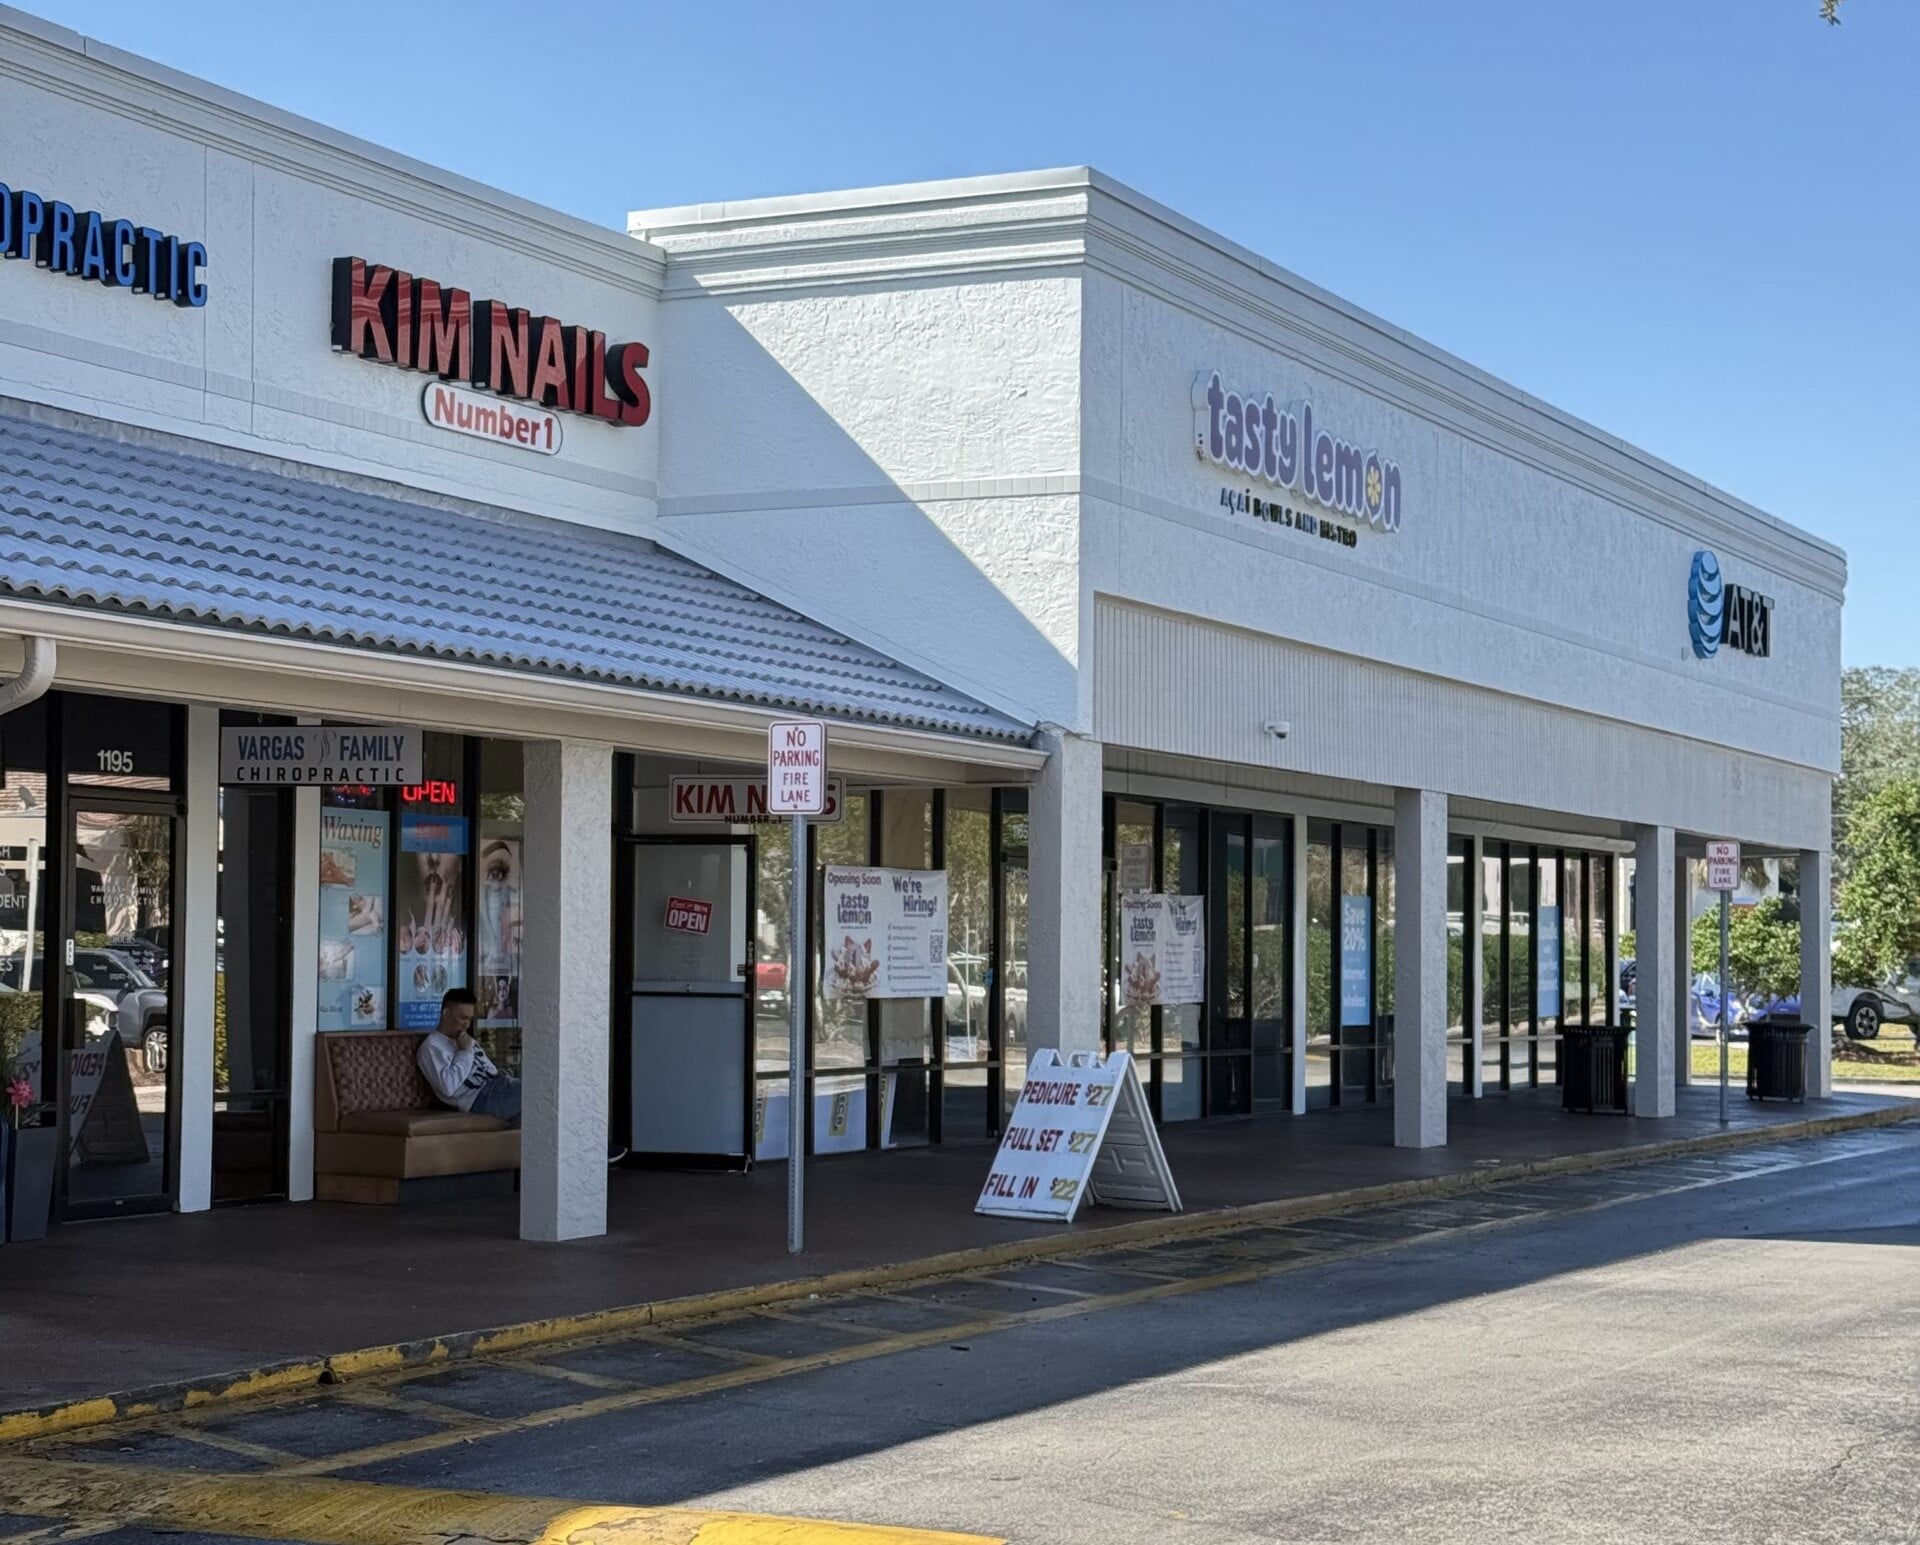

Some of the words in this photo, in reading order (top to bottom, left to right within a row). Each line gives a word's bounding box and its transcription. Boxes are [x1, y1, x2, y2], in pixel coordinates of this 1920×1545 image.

[334, 255, 472, 383] KIM
[475, 299, 651, 428] NAILS
[1208, 372, 1298, 487] tasty
[1303, 401, 1401, 531] lemon
[1295, 512, 1317, 534] AND
[1723, 583, 1775, 658] AT&T
[237, 735, 305, 761] VARGAS
[339, 735, 405, 762] FAMILY
[786, 729, 807, 748] NO
[97, 749, 134, 773] 1195
[773, 749, 820, 768] PARKING
[236, 766, 405, 783] CHIROPRACTIC
[783, 772, 809, 786] FIRE
[402, 780, 456, 804] OPEN
[676, 784, 736, 814] KIM
[781, 790, 811, 803] LANE
[323, 815, 383, 849] Waxing
[1709, 857, 1737, 865] PARKING
[1716, 846, 1729, 855] NO
[828, 872, 860, 888] Opening
[861, 872, 882, 886] Soon
[1714, 876, 1732, 885] LANE
[1715, 868, 1731, 876] FIRE
[892, 875, 923, 893] We're
[840, 892, 869, 910] tasty
[903, 895, 938, 918] Hiring!
[668, 908, 708, 931] OPEN
[837, 903, 872, 924] lemon
[1132, 914, 1154, 930] tasty
[1344, 901, 1366, 926] Save
[1343, 926, 1367, 952] 20%
[1020, 1080, 1082, 1106] PEDICURE
[1085, 1083, 1114, 1107] $27
[1003, 1126, 1036, 1151] FULL
[1036, 1128, 1064, 1152] SET
[1067, 1130, 1099, 1155] $27
[983, 1173, 1017, 1198] FILL
[1018, 1176, 1040, 1199] IN
[1049, 1177, 1080, 1201] $22
